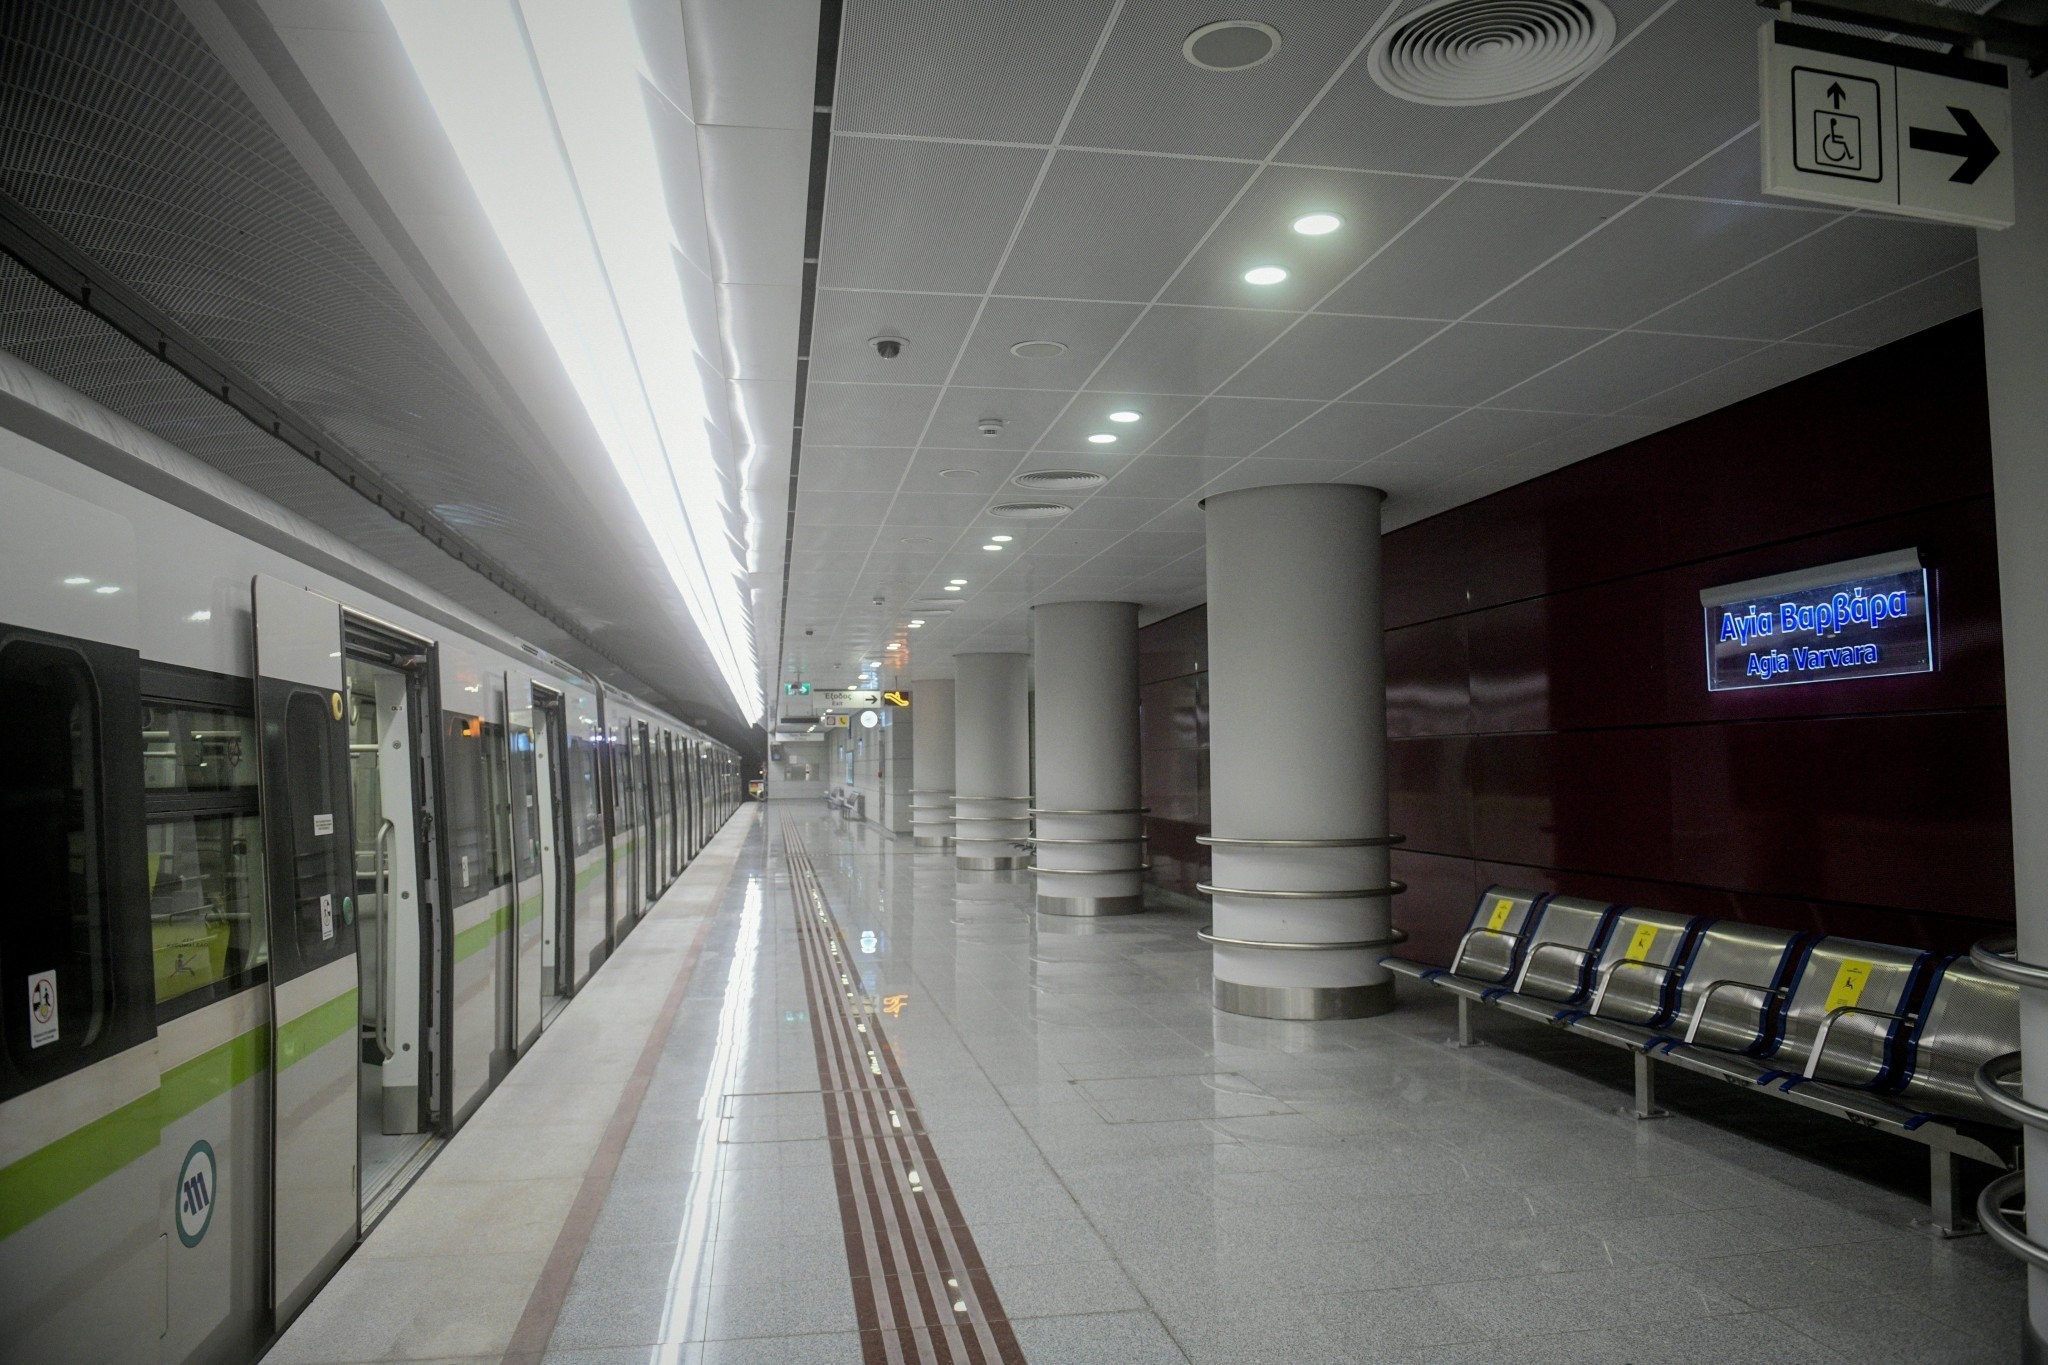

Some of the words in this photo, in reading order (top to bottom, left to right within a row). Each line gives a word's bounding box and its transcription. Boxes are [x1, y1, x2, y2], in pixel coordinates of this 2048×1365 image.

[1720, 605, 1773, 645] Αγία
[1779, 587, 1908, 636] Βαρβάρα
[1747, 652, 1789, 679] Agia
[1793, 643, 1878, 671] Varvara
